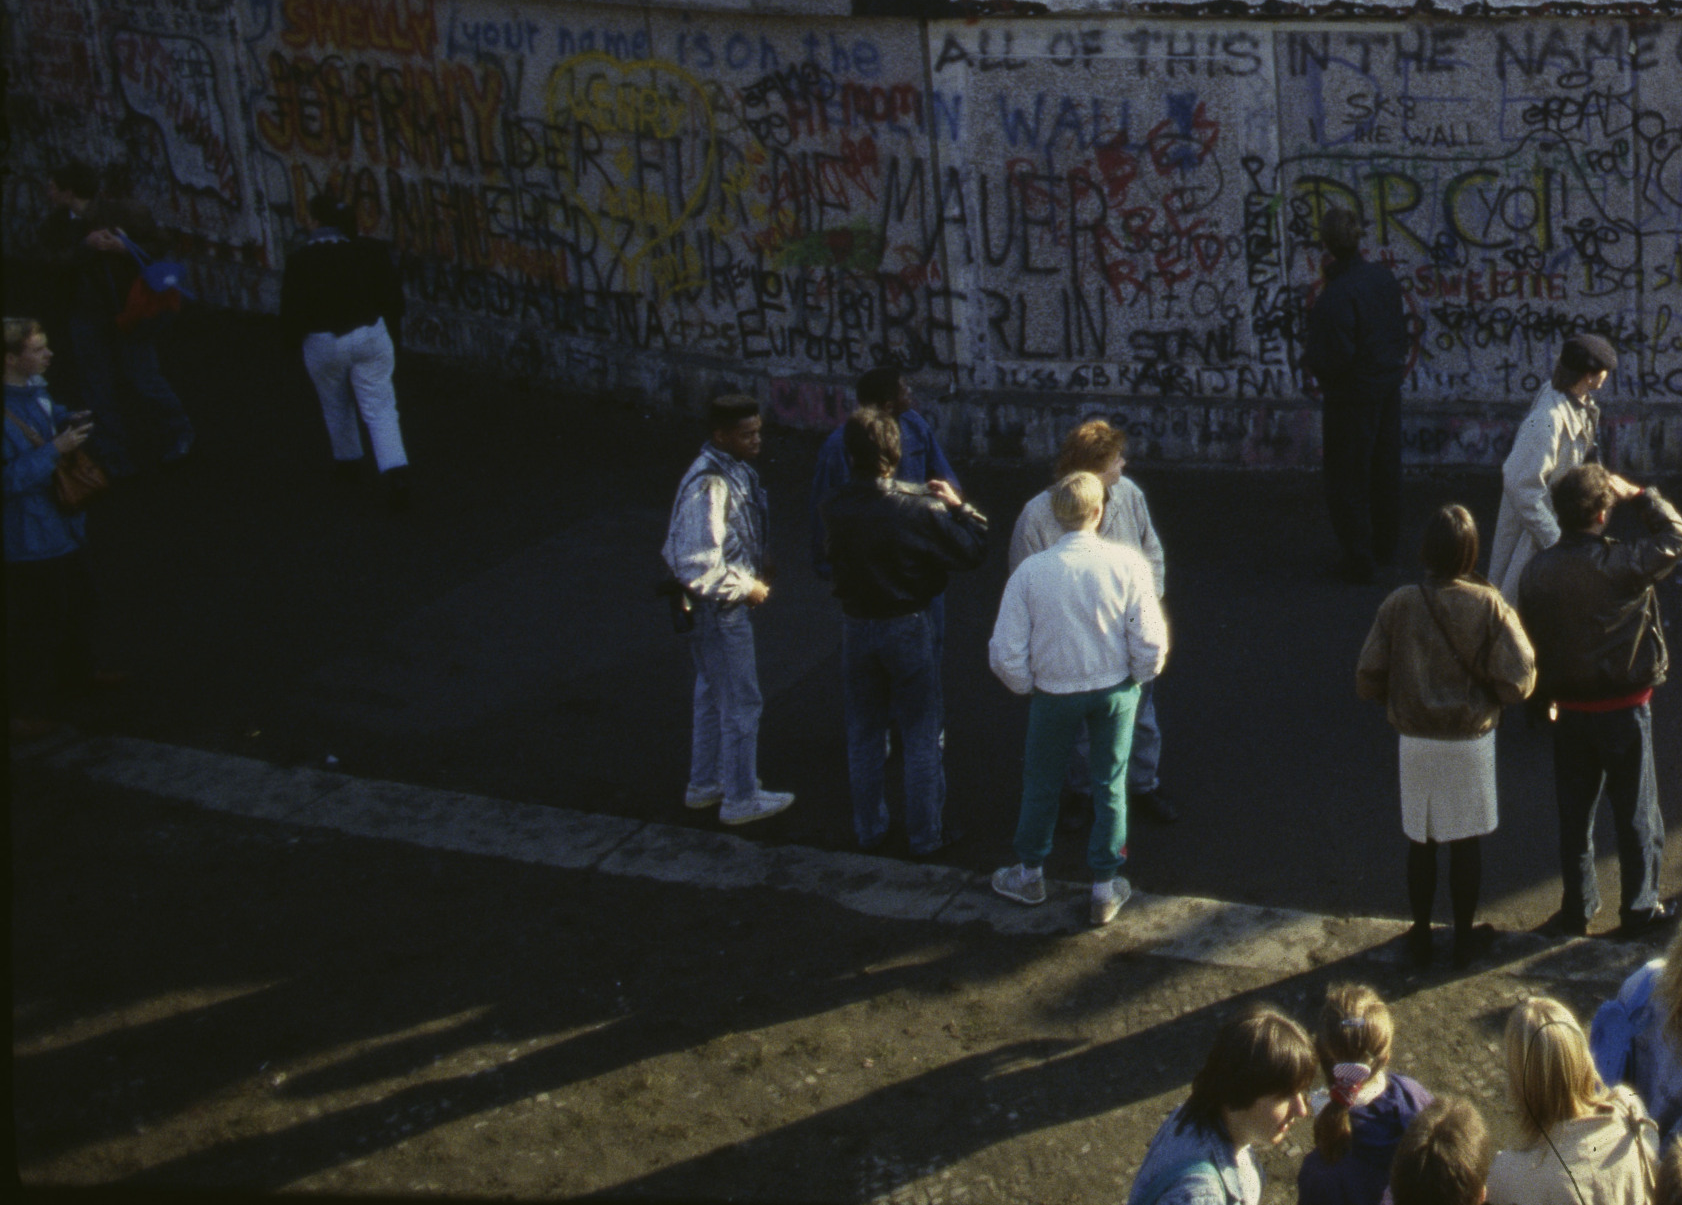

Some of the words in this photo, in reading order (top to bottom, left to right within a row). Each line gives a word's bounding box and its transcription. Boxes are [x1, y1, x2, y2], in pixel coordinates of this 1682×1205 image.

[557, 25, 652, 63] name
[802, 26, 883, 79] the
[934, 29, 1027, 74] ALL
[1047, 28, 1105, 70] OF
[1123, 26, 1263, 80] THIS
[1287, 29, 1331, 77] IN
[1342, 25, 1468, 79] THE
[1495, 19, 1664, 81] NAME
[1402, 122, 1485, 147] WALL
